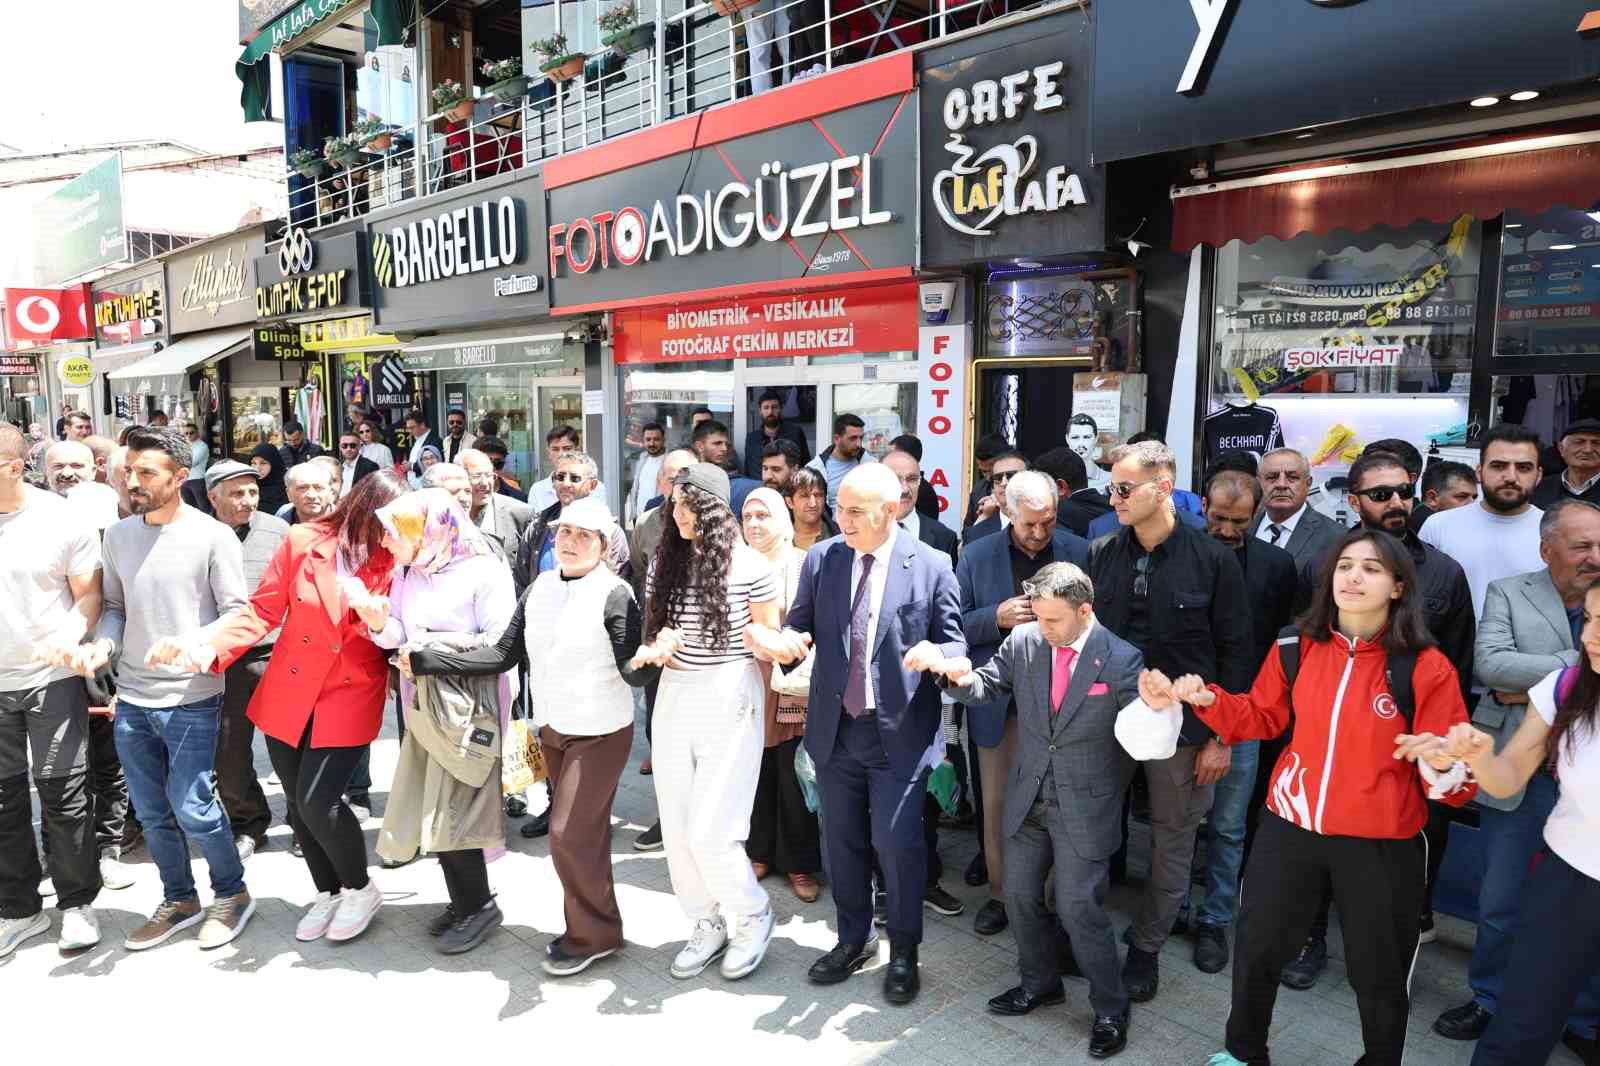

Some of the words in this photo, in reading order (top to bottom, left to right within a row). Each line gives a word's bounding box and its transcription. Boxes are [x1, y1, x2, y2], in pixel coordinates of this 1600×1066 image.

[943, 61, 1063, 130] CAFE
[392, 195, 517, 288] BARGELLO
[494, 274, 538, 297] Perfume
[667, 303, 750, 330] BİYOMETRİK
[763, 297, 846, 322] VESİKALIK
[462, 345, 496, 366] BARGELLO
[661, 334, 730, 357] FOTOĞRAF
[732, 329, 779, 357] ÇEKİM
[782, 323, 854, 350] MERKEZİ
[1287, 351, 1329, 369] ŞOK
[1336, 347, 1400, 365] FİYAT
[928, 335, 953, 435] FOTO
[1219, 434, 1264, 449] BECKHAM
